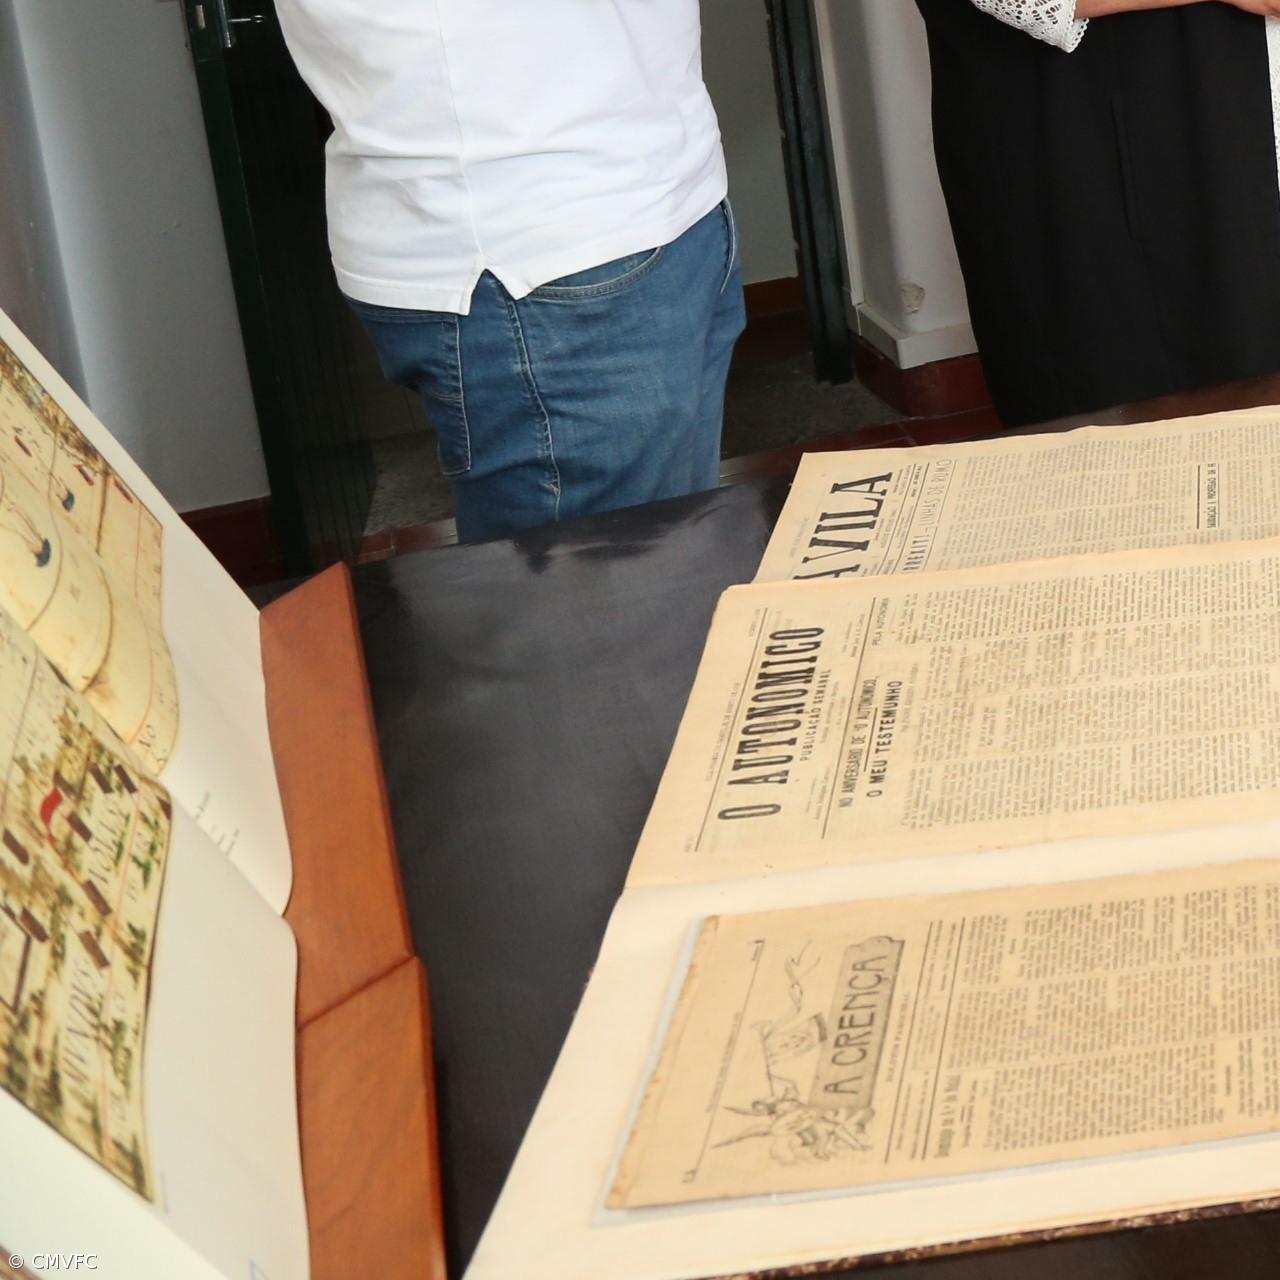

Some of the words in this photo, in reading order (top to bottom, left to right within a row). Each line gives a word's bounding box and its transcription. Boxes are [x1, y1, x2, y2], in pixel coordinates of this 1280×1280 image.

[933, 459, 952, 482] RUMO
[927, 483, 945, 496] DE
[801, 472, 893, 563] VILA
[919, 499, 940, 526] LINHAS
[727, 627, 825, 785] AUTONOMICO
[800, 707, 822, 762] PUBLICAÇÃO
[813, 669, 832, 705] SEMANAL
[875, 680, 903, 754] TESTEMUNHO
[839, 797, 853, 807] NO
[851, 734, 866, 745] DE
[869, 759, 888, 784] MEU
[866, 789, 883, 798] O
[717, 803, 781, 820] O
[831, 955, 889, 1066] CRENÇA
[824, 1076, 863, 1095] A
